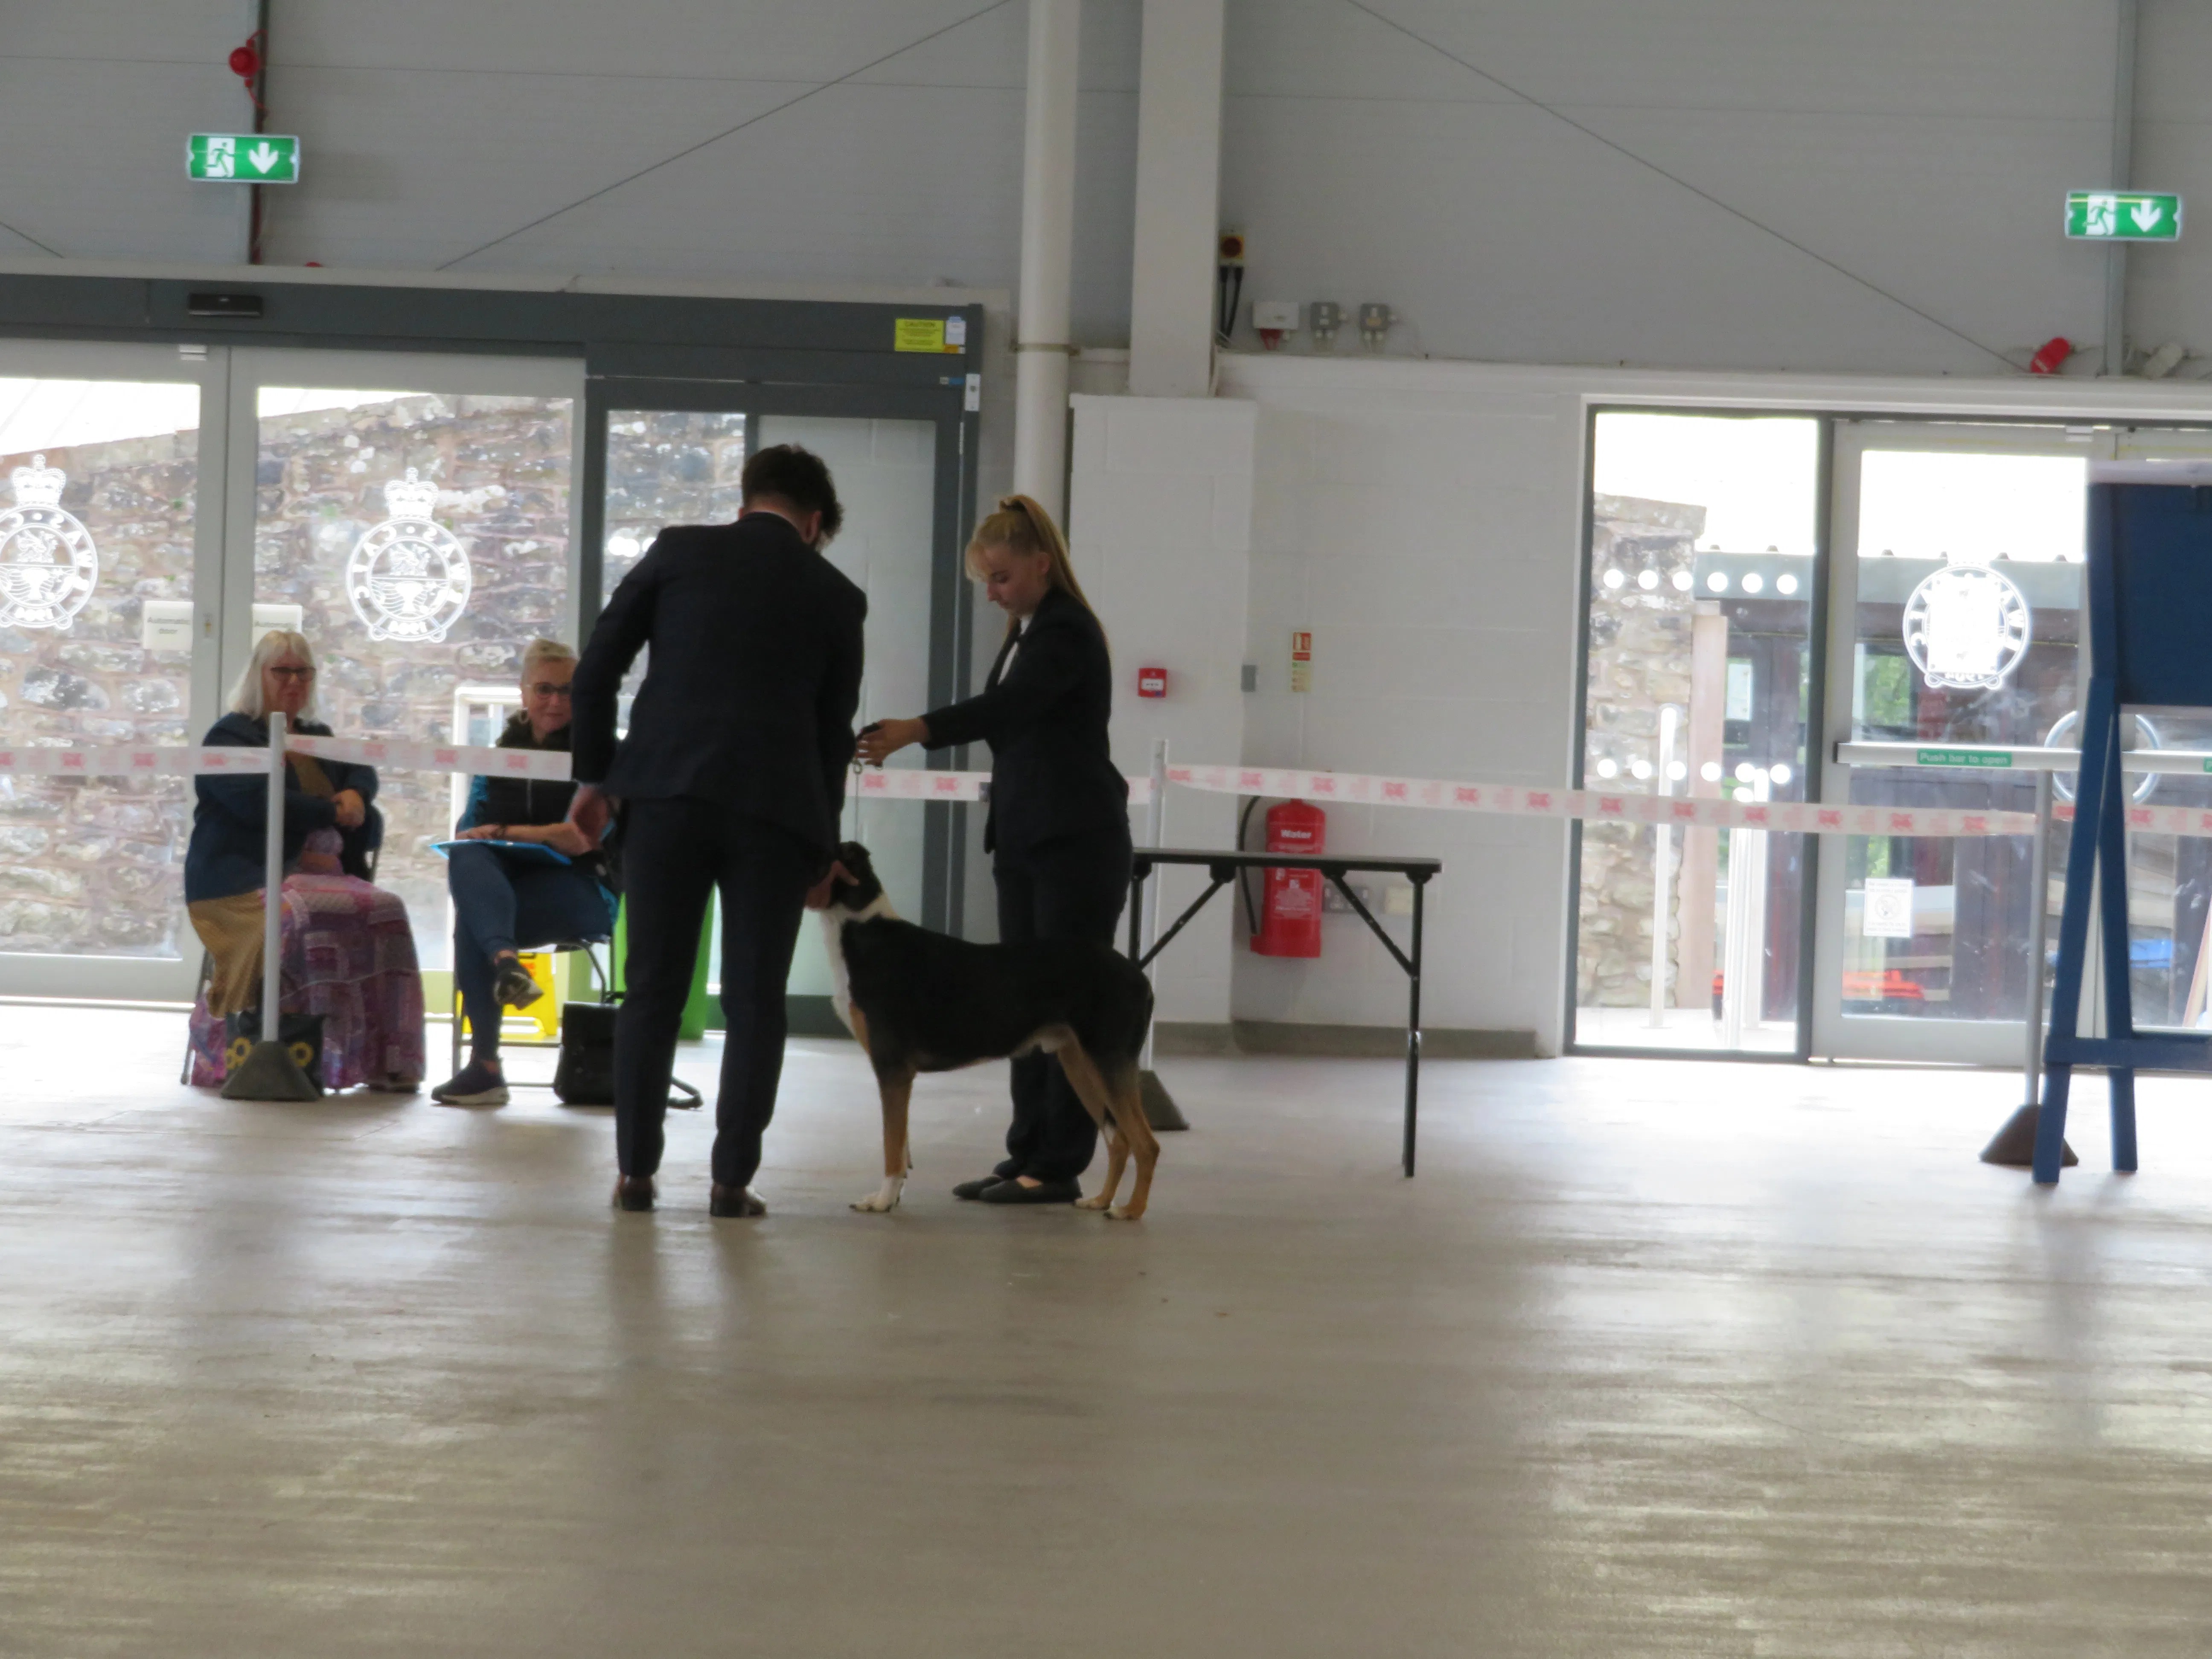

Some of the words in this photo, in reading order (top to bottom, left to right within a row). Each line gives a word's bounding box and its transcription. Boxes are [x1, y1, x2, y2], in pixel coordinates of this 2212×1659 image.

[1920, 752, 1946, 762] Push
[1949, 754, 1965, 763] bar
[1969, 755, 1979, 763] to
[1281, 829, 1312, 839] Water
